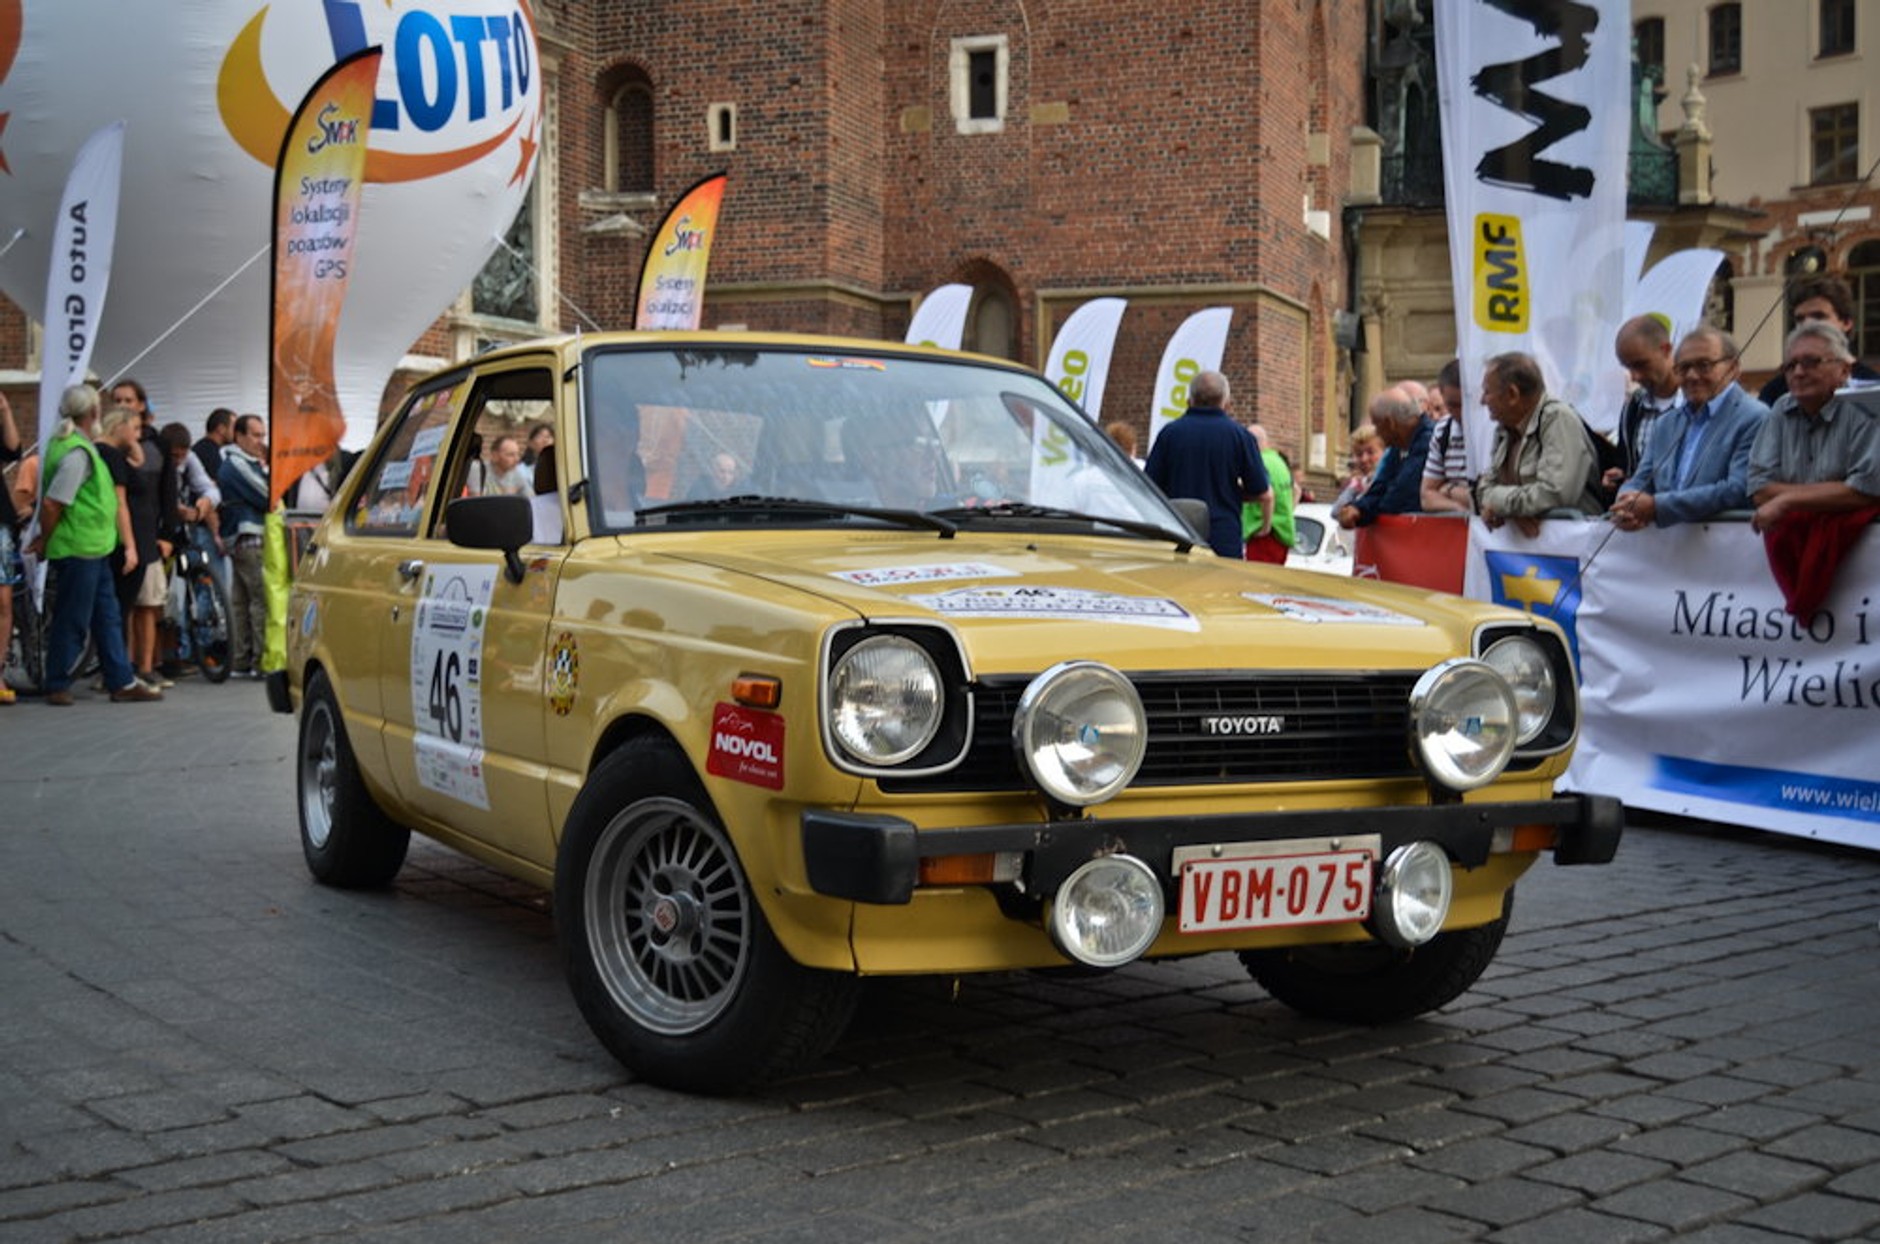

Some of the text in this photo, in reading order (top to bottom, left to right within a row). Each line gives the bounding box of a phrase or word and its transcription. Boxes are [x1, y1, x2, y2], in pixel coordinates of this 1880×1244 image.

[322, 0, 529, 131] LOTTO
[314, 259, 347, 279] GPS
[1483, 221, 1520, 323] RMF
[1856, 597, 1870, 646] i
[429, 648, 462, 745] 46
[714, 731, 778, 764] NOVOL
[1208, 717, 1281, 734] TOYOTA
